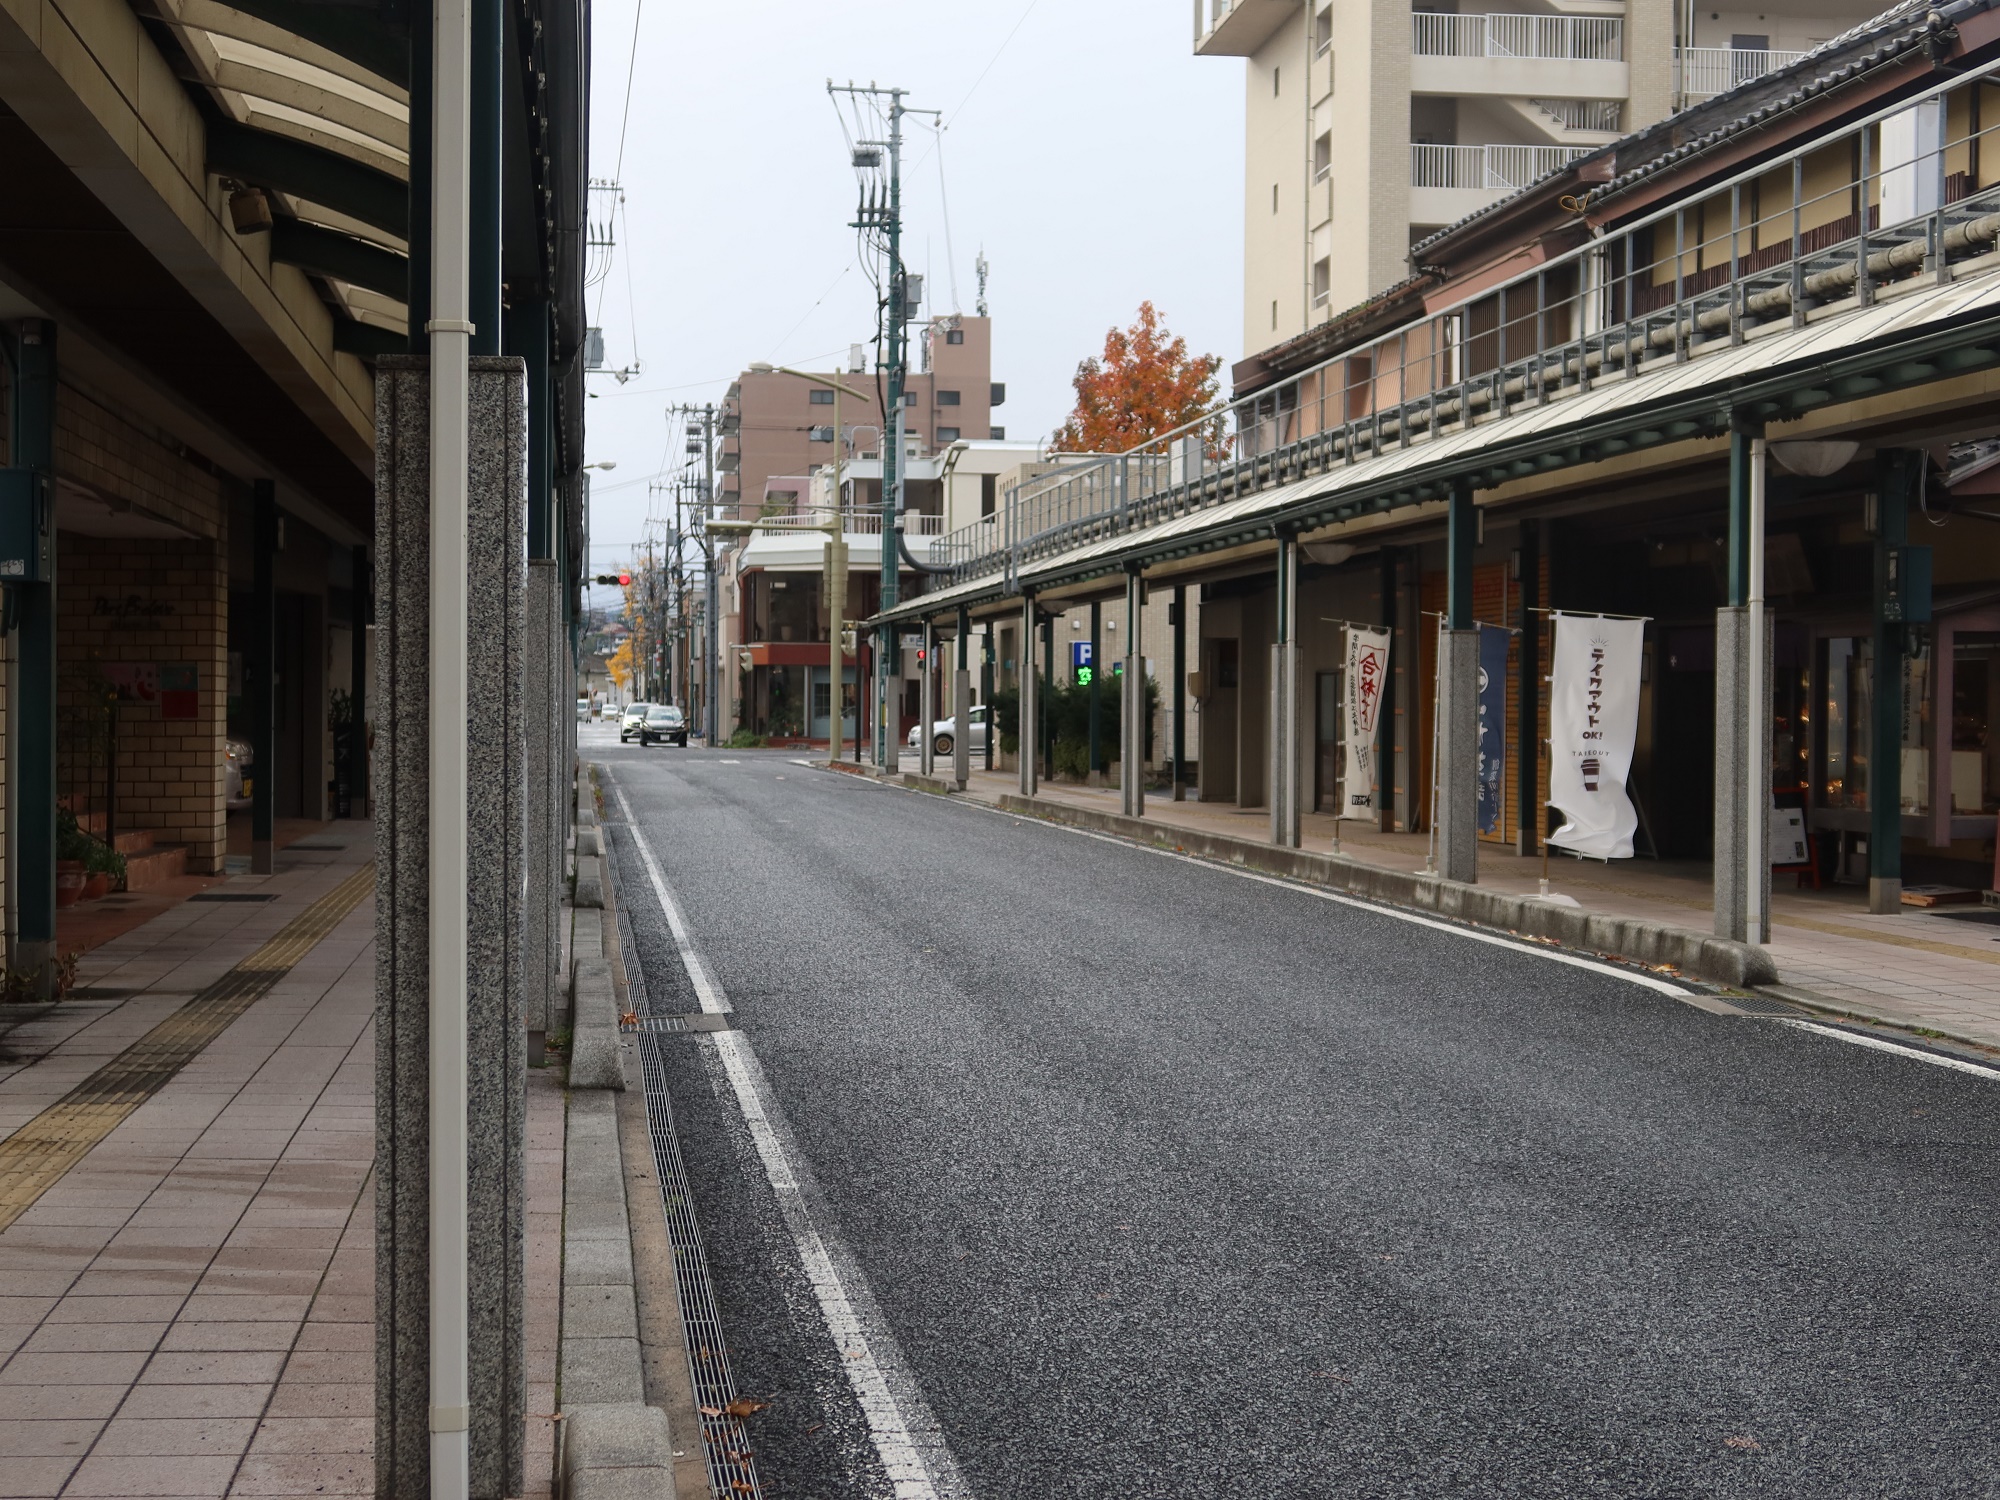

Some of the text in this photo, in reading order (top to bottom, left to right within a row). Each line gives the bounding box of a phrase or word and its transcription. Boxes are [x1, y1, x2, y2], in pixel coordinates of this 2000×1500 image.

[1080, 644, 1092, 664] P
[1588, 649, 1605, 728] テイクアウト
[1582, 731, 1604, 740] OK!
